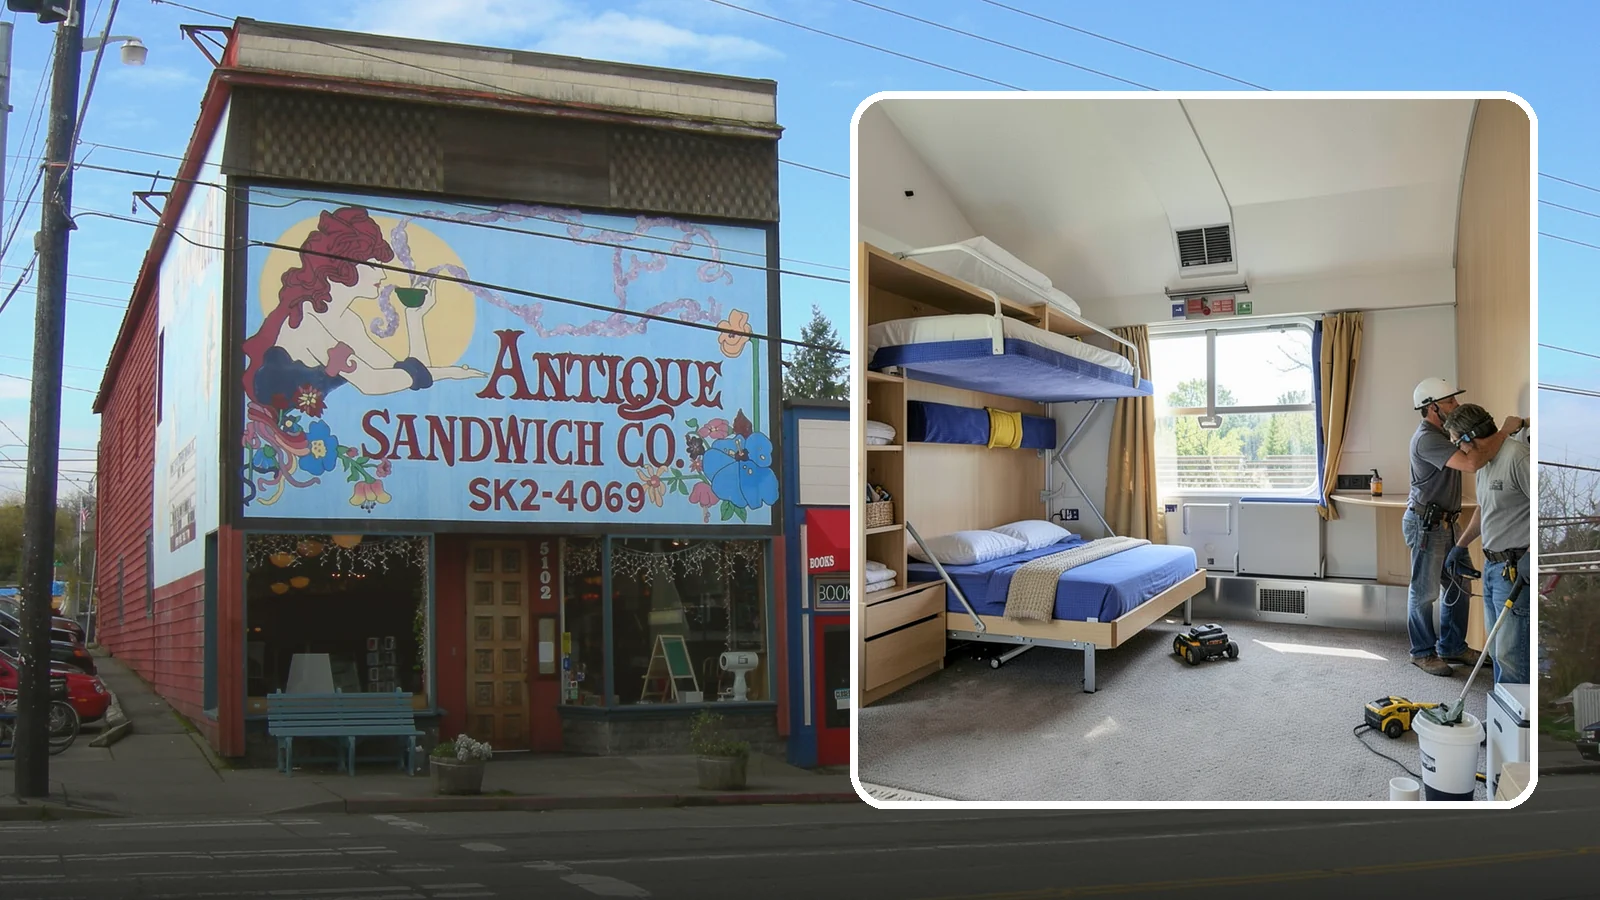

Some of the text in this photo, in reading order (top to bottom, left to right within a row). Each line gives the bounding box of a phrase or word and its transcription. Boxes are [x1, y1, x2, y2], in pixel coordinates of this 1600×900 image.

[476, 329, 724, 420] ANTIQUE
[361, 408, 685, 468] SANDWICH CO.
[468, 477, 646, 512] SK2-4069
[539, 541, 552, 600] 5102
[809, 555, 835, 569] BOOKS
